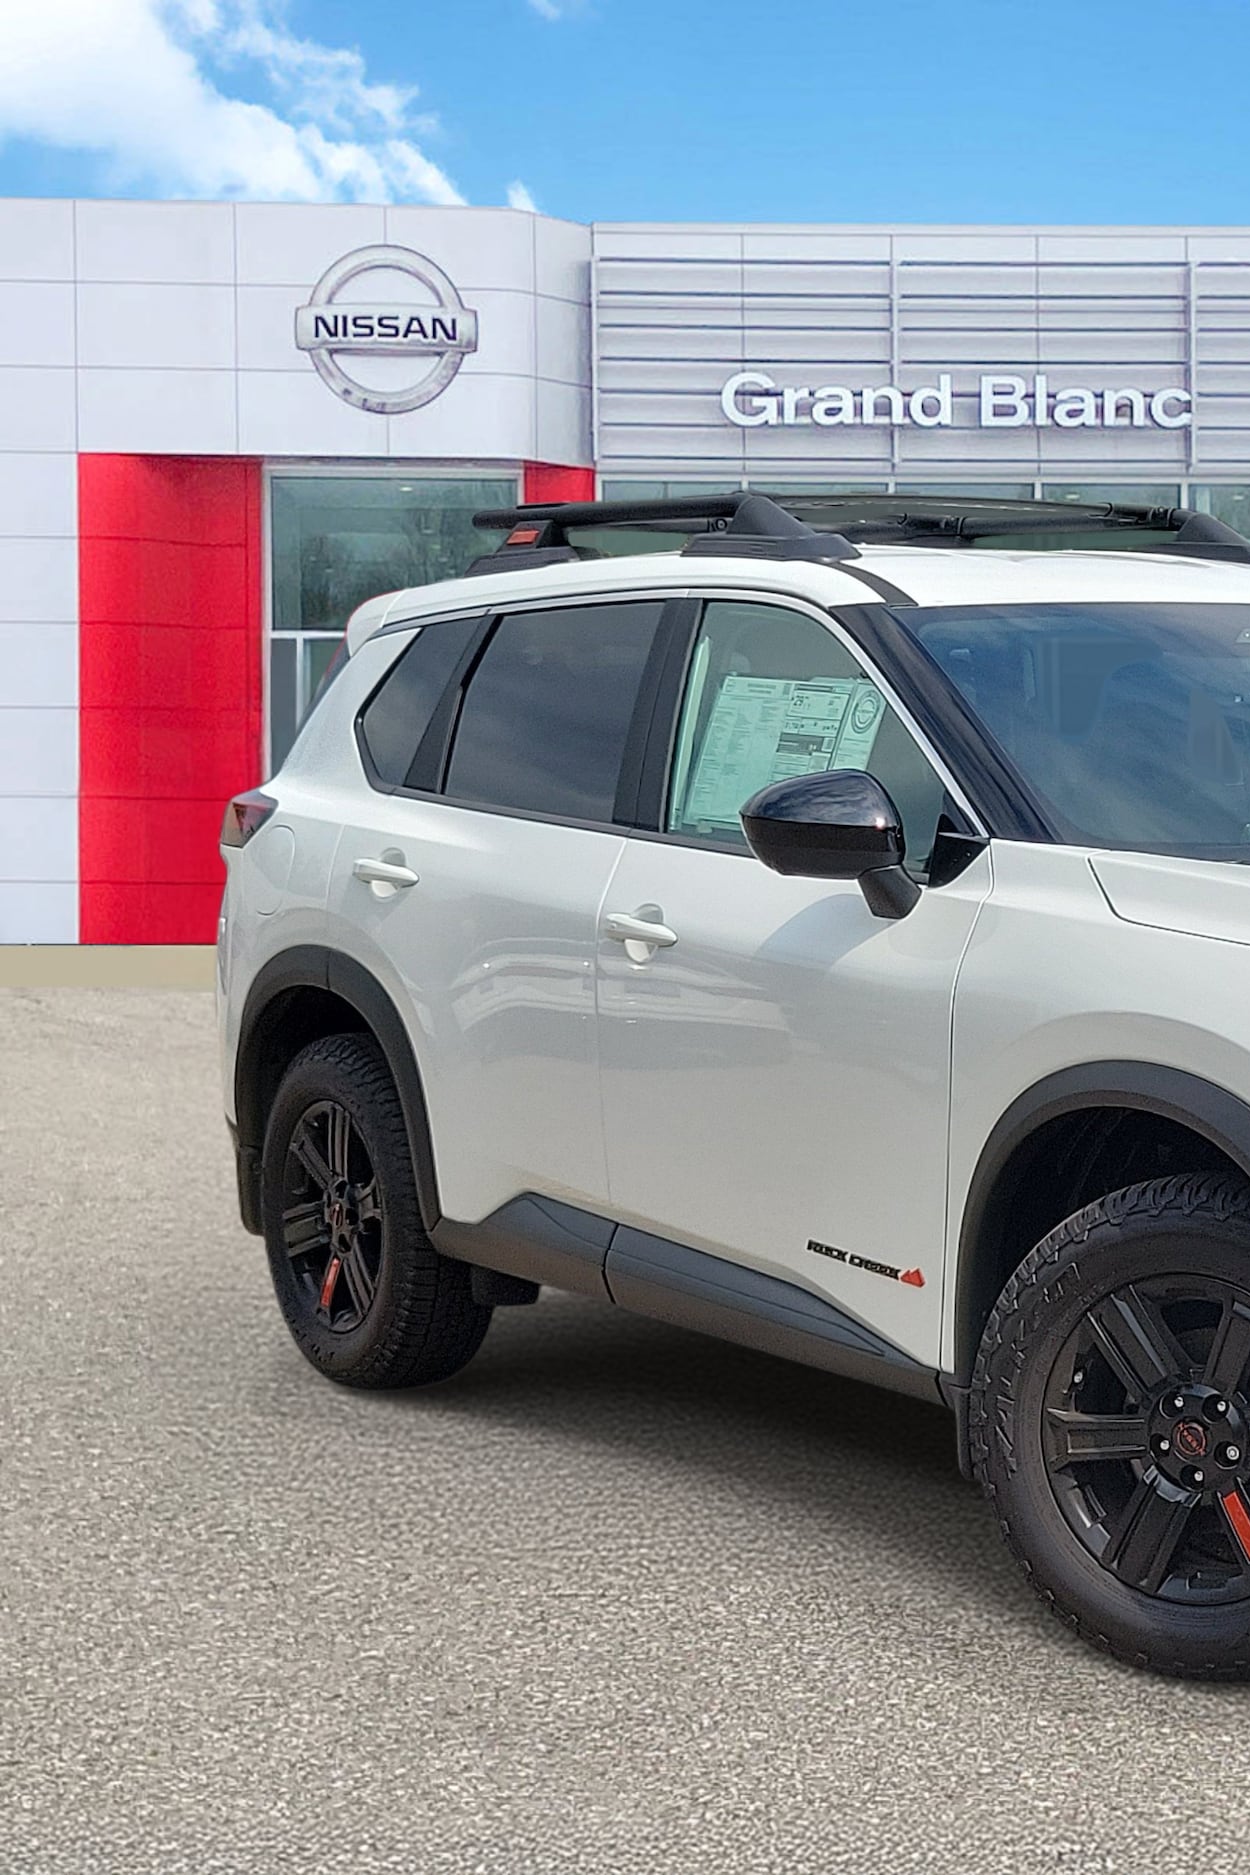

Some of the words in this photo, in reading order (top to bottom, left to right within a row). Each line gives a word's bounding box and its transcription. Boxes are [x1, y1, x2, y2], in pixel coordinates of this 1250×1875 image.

[314, 315, 457, 341] NISSAN
[720, 372, 951, 428] Grand
[979, 374, 1193, 428] Blanc
